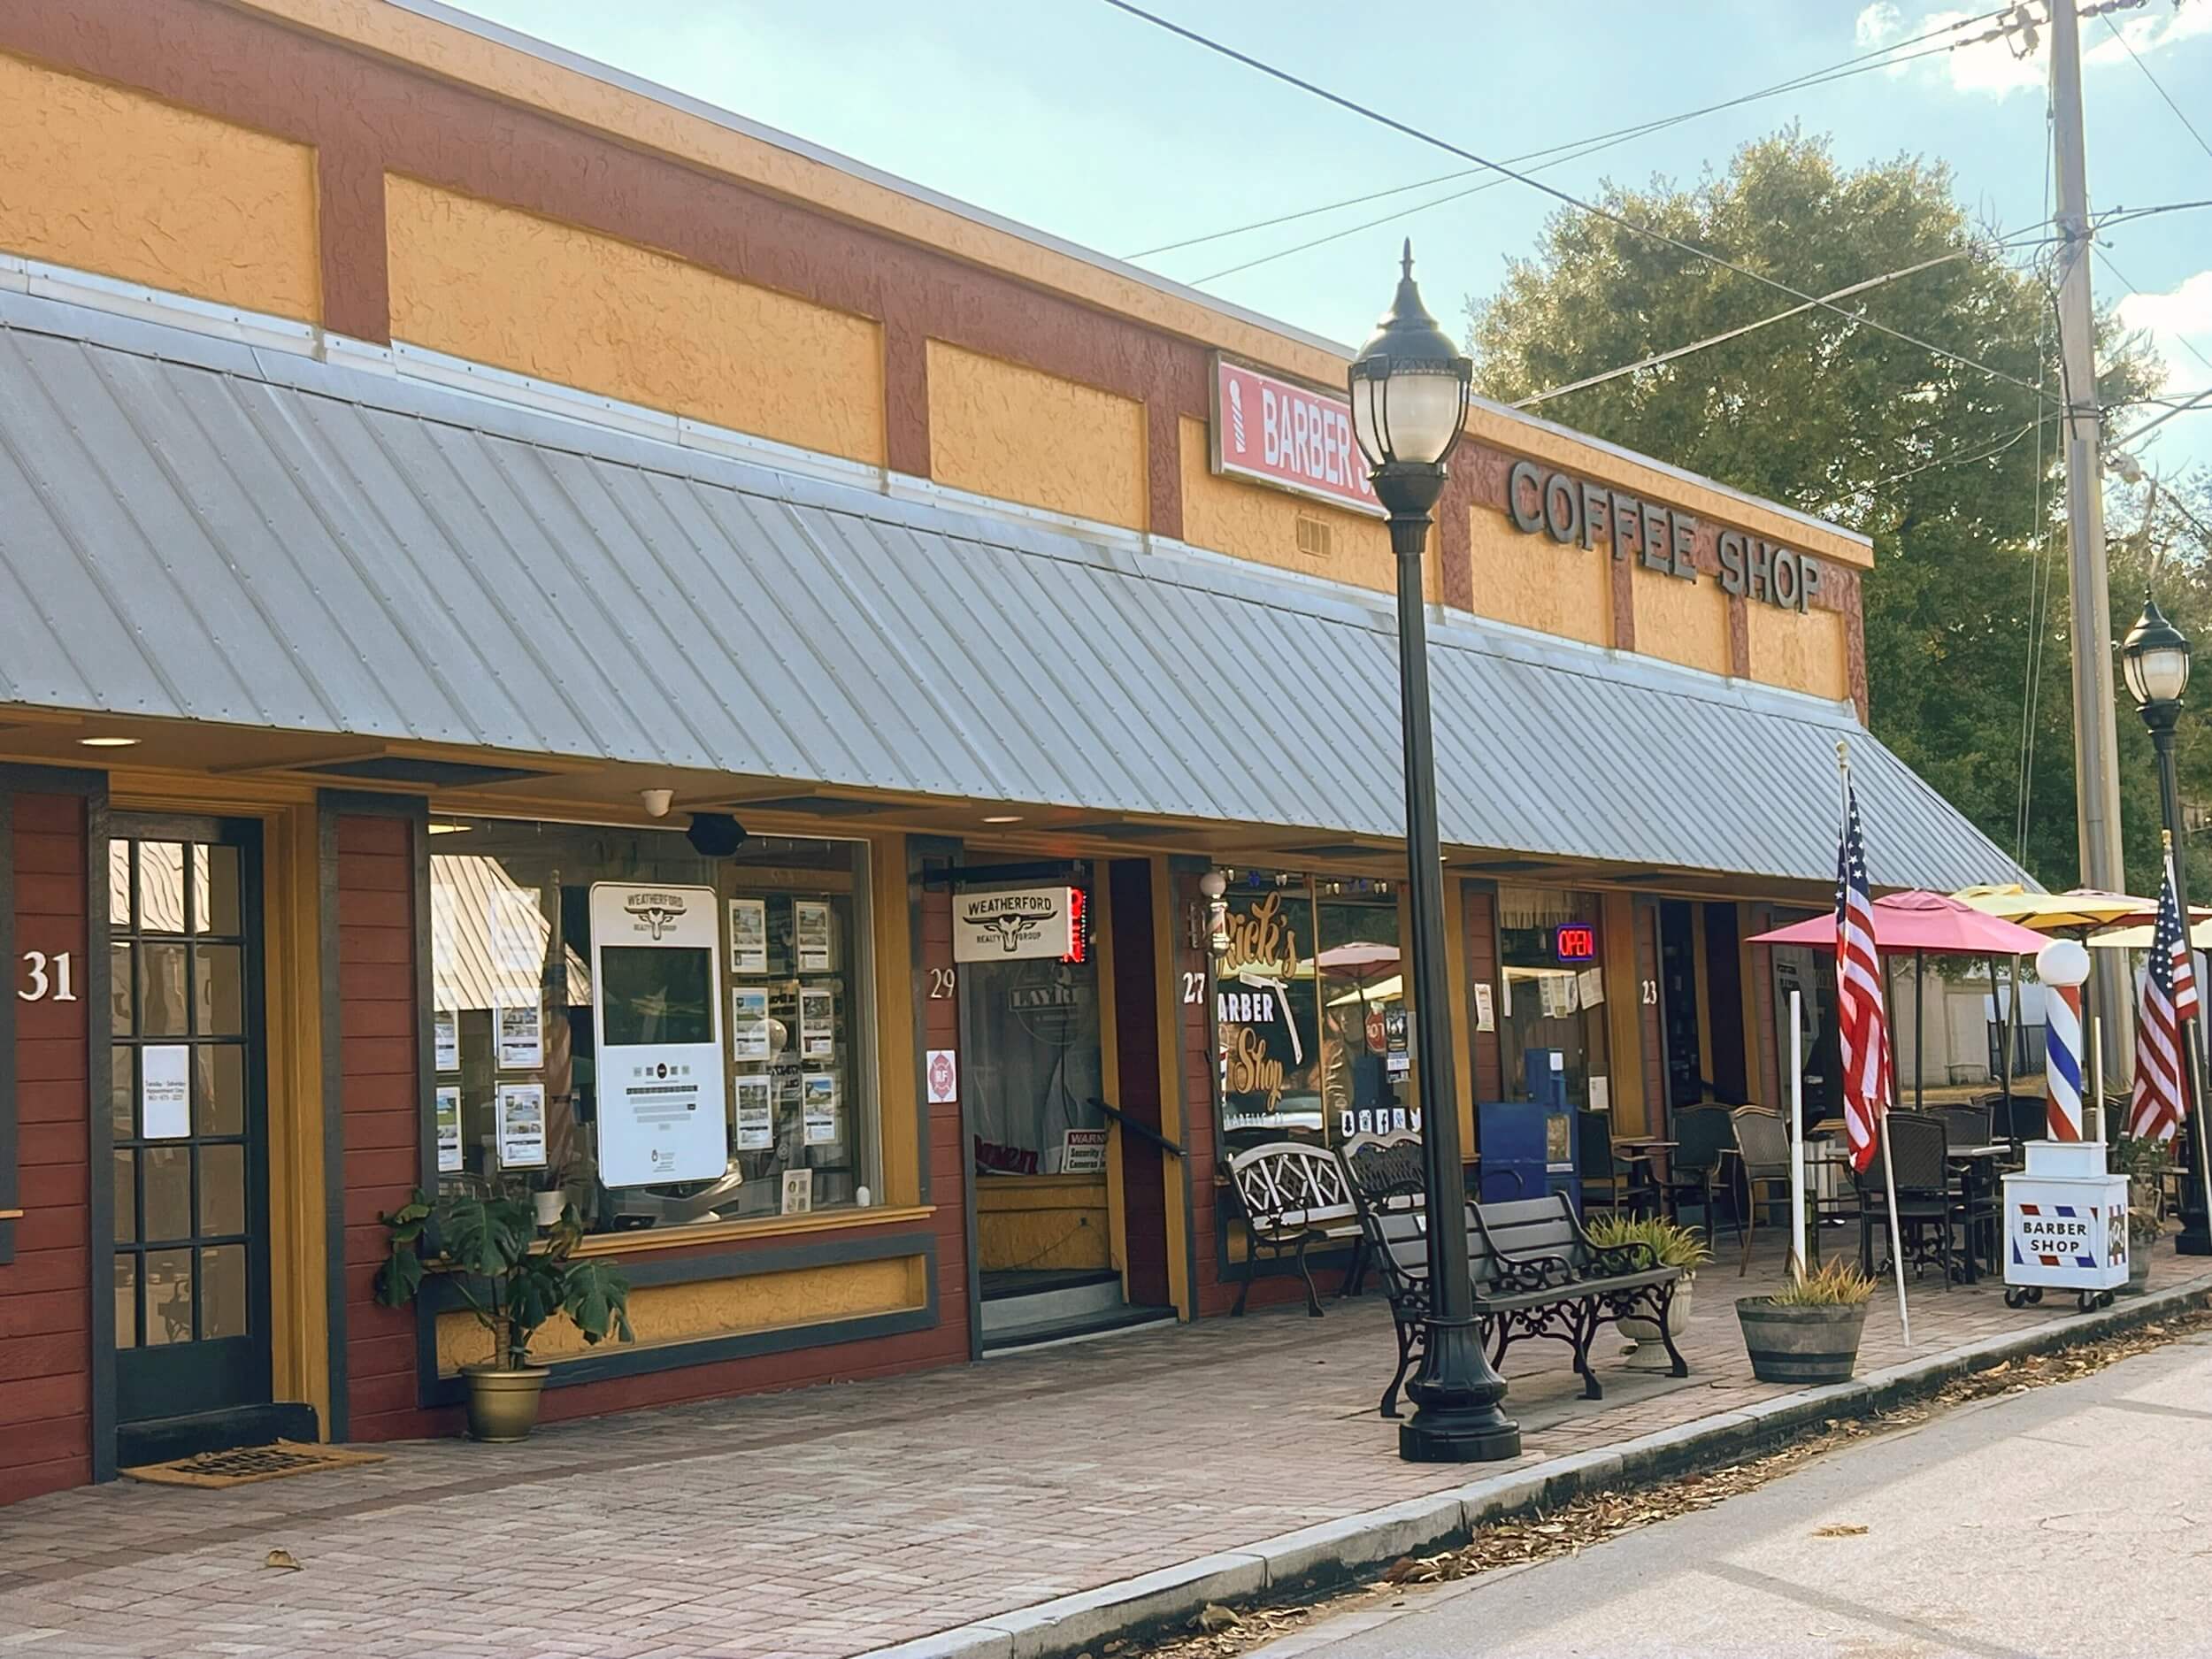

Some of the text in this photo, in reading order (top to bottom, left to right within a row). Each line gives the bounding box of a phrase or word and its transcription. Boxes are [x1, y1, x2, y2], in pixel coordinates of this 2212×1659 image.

[1263, 388, 1354, 489] BARBER
[1509, 461, 1821, 614] COFFEE SHOP
[626, 894, 684, 908] WEATHERFORD
[968, 896, 1052, 916] WEATHERFORD
[976, 934, 1001, 944] REALTY
[1558, 930, 1593, 956] OPEN
[18, 950, 77, 1002] 31
[930, 968, 956, 999] 29
[1182, 972, 1205, 1005] 27
[1641, 979, 1657, 1005] 23
[1217, 993, 1275, 1022] ARBER
[1233, 1026, 1283, 1112] Shop
[1071, 1133, 1106, 1144] WARN
[1069, 1159, 1098, 1169] Cameras
[1070, 1148, 1099, 1158] Security
[2023, 1222, 2087, 1235] BARBER
[2030, 1240, 2080, 1253] SHOP
